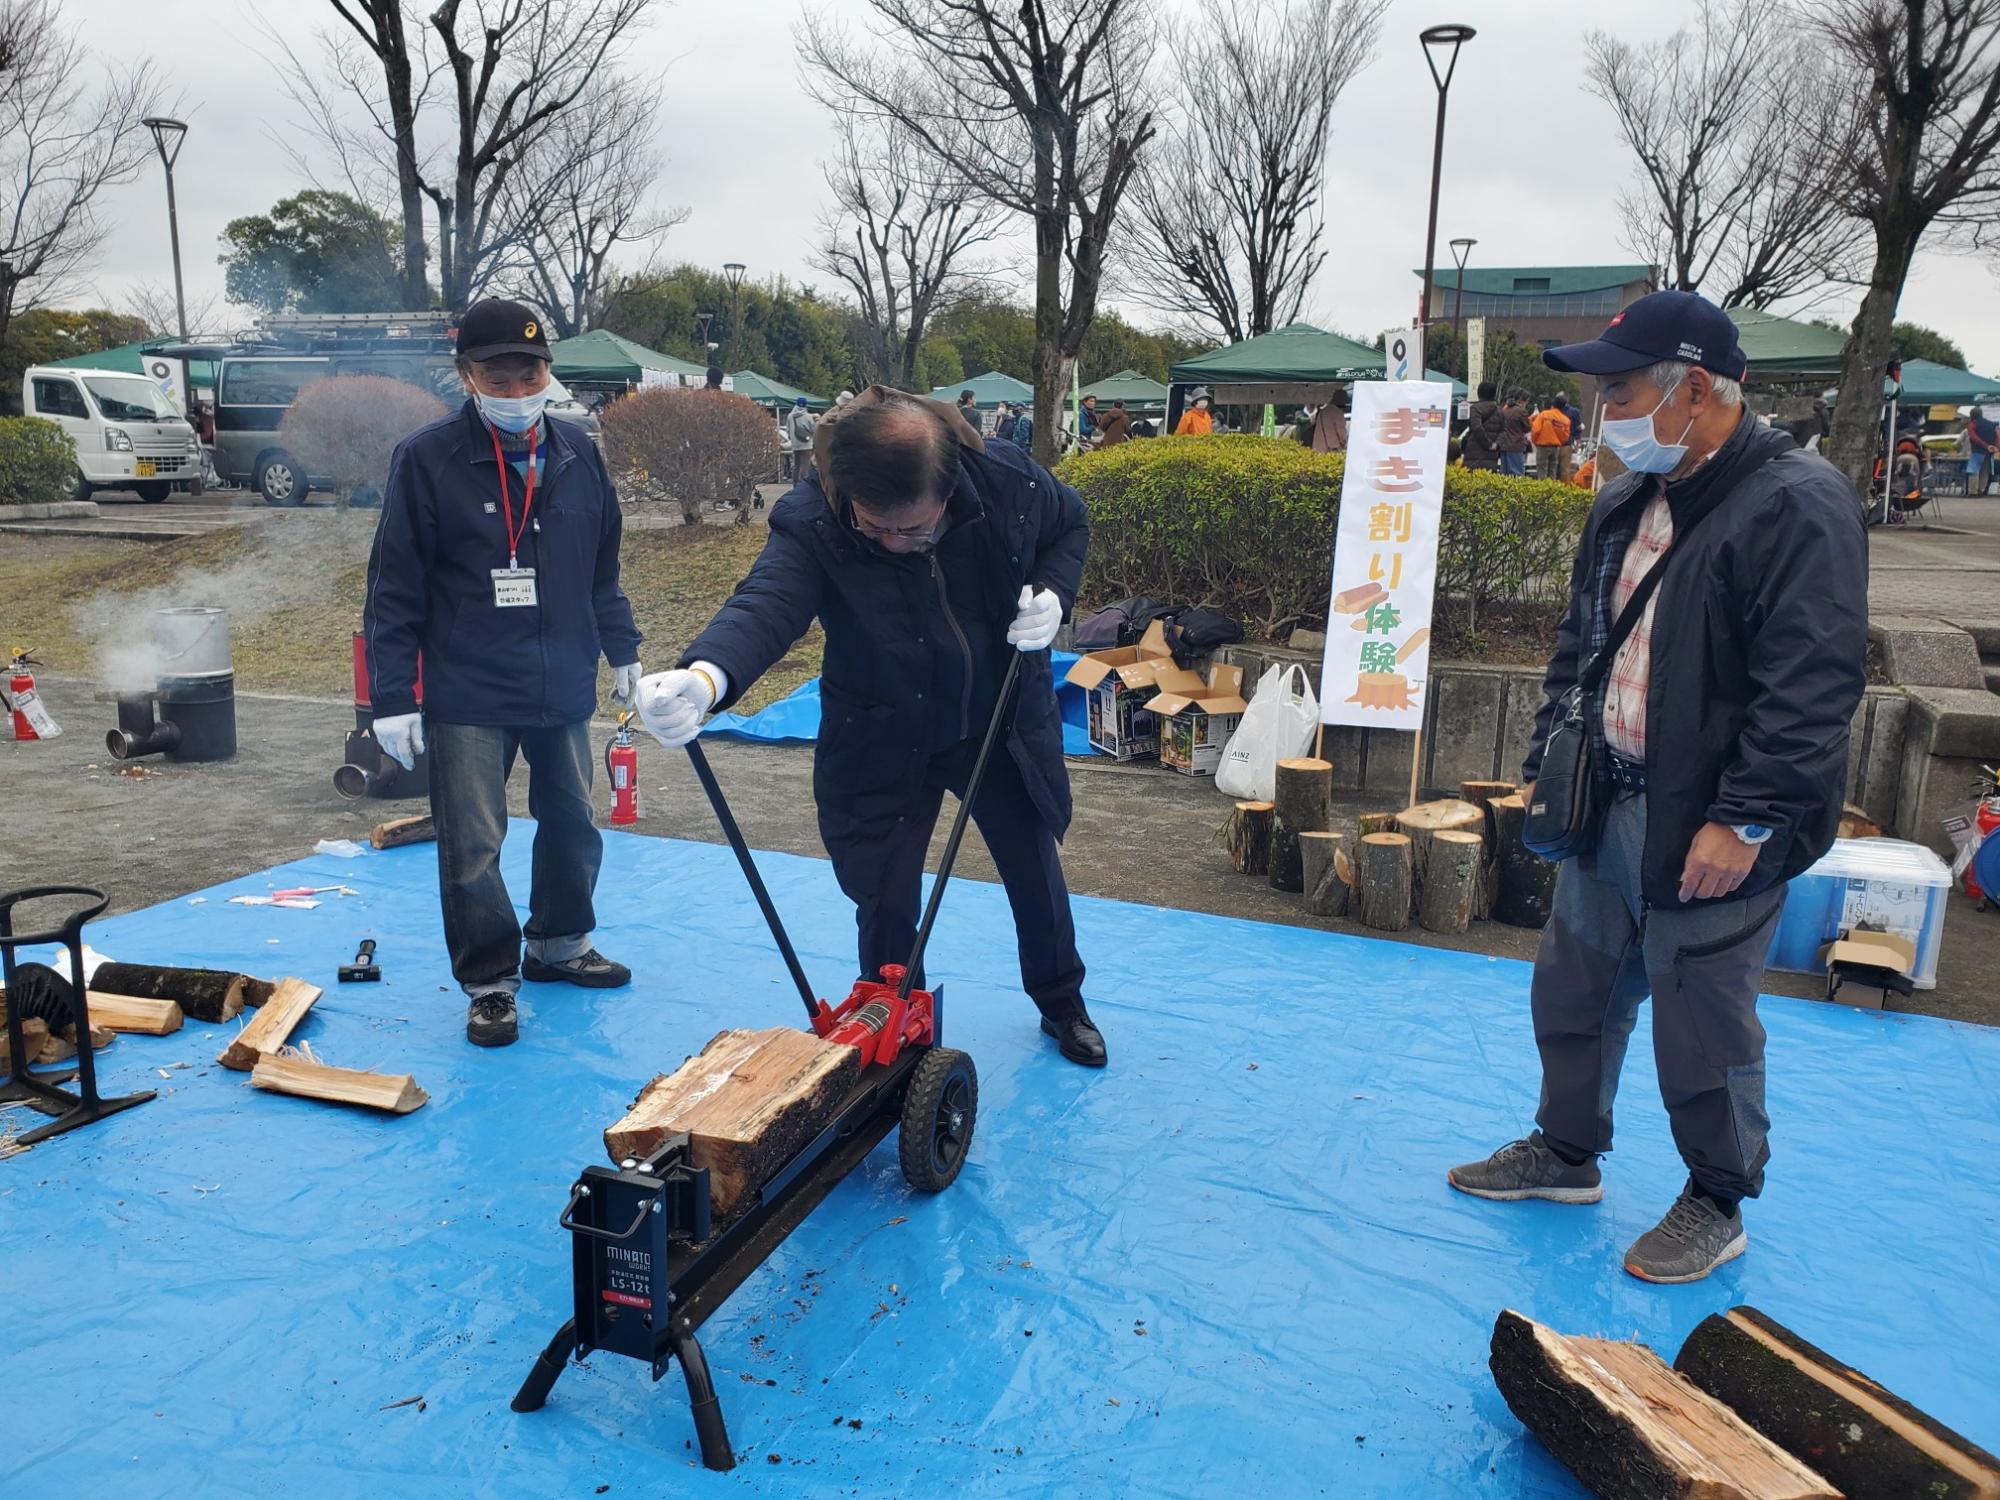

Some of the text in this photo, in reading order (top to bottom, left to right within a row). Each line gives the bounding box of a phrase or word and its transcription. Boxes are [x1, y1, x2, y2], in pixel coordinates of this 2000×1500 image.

[1358, 407, 1428, 674] まき割り体験
[606, 1246, 651, 1265] MINATO
[611, 1276, 650, 1294] LS-12t
